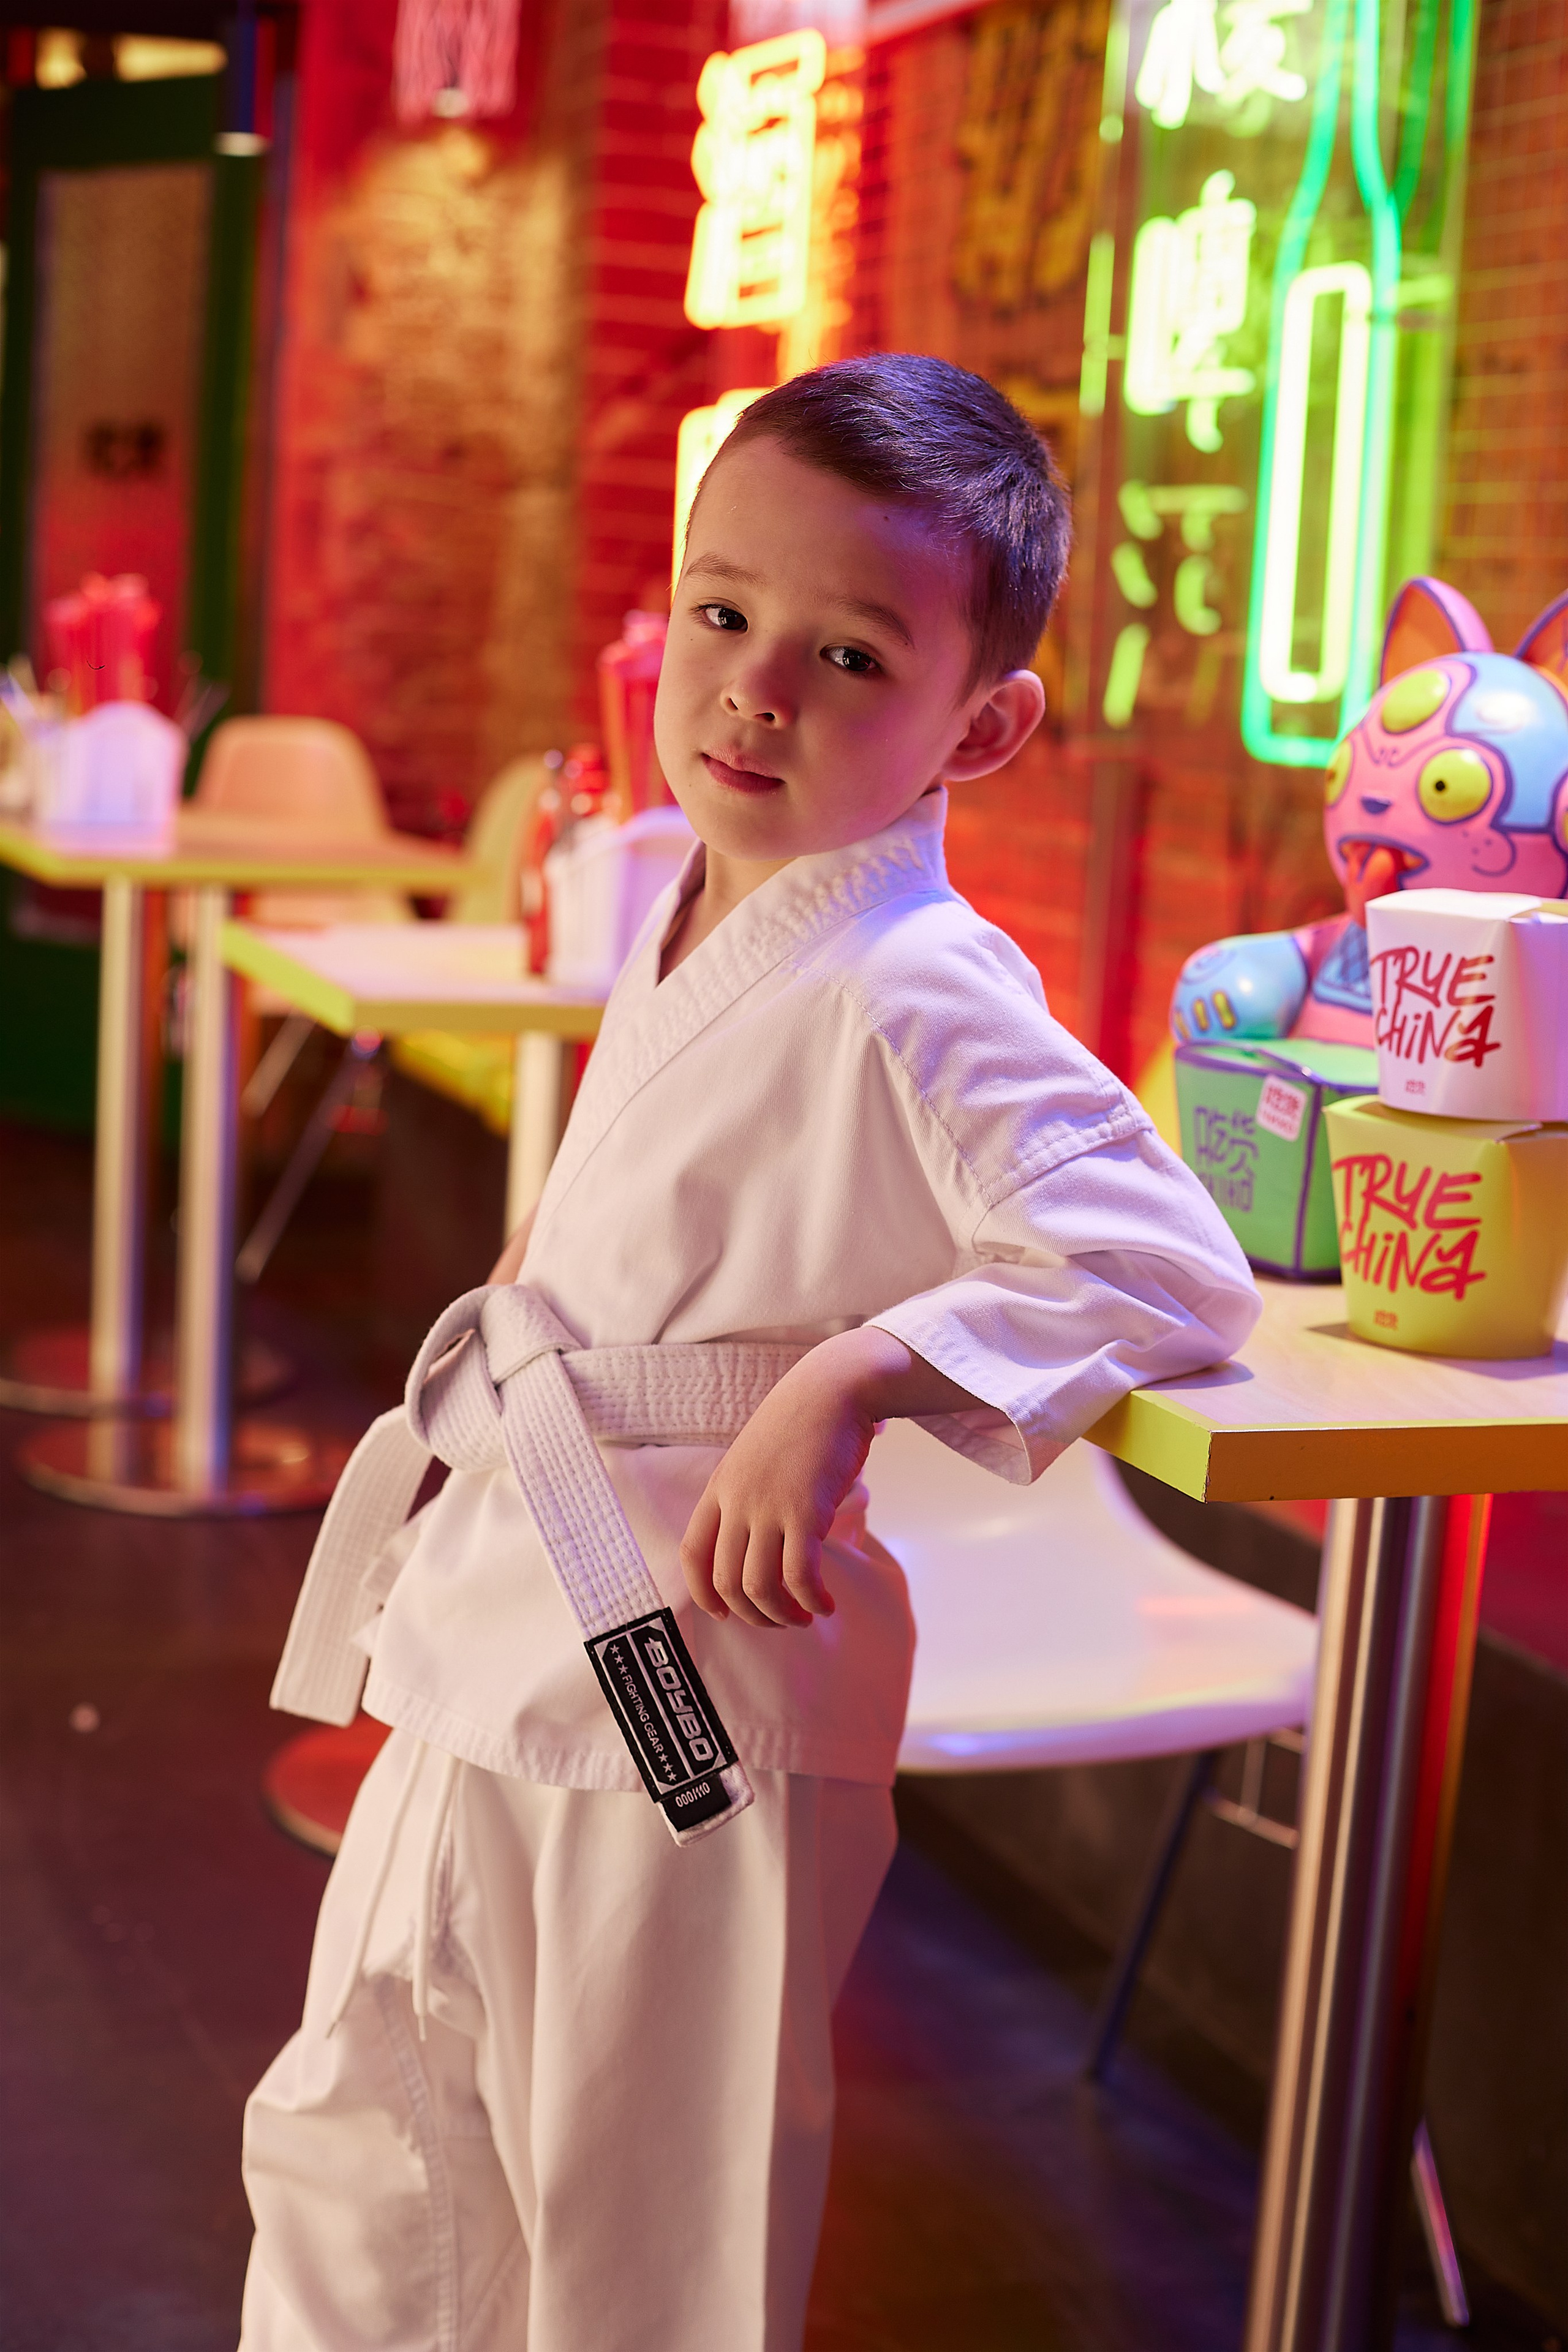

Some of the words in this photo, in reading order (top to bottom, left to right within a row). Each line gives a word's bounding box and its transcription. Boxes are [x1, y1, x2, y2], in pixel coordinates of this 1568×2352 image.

[1370, 946, 1495, 1008] TRUE
[1332, 1153, 1482, 1231] TRUE
[622, 1674, 650, 1722] FIGHTING
[644, 1722, 664, 1754] GEAR
[644, 1637, 714, 1761] BOYBO
[676, 1782, 710, 1807] 000/110
